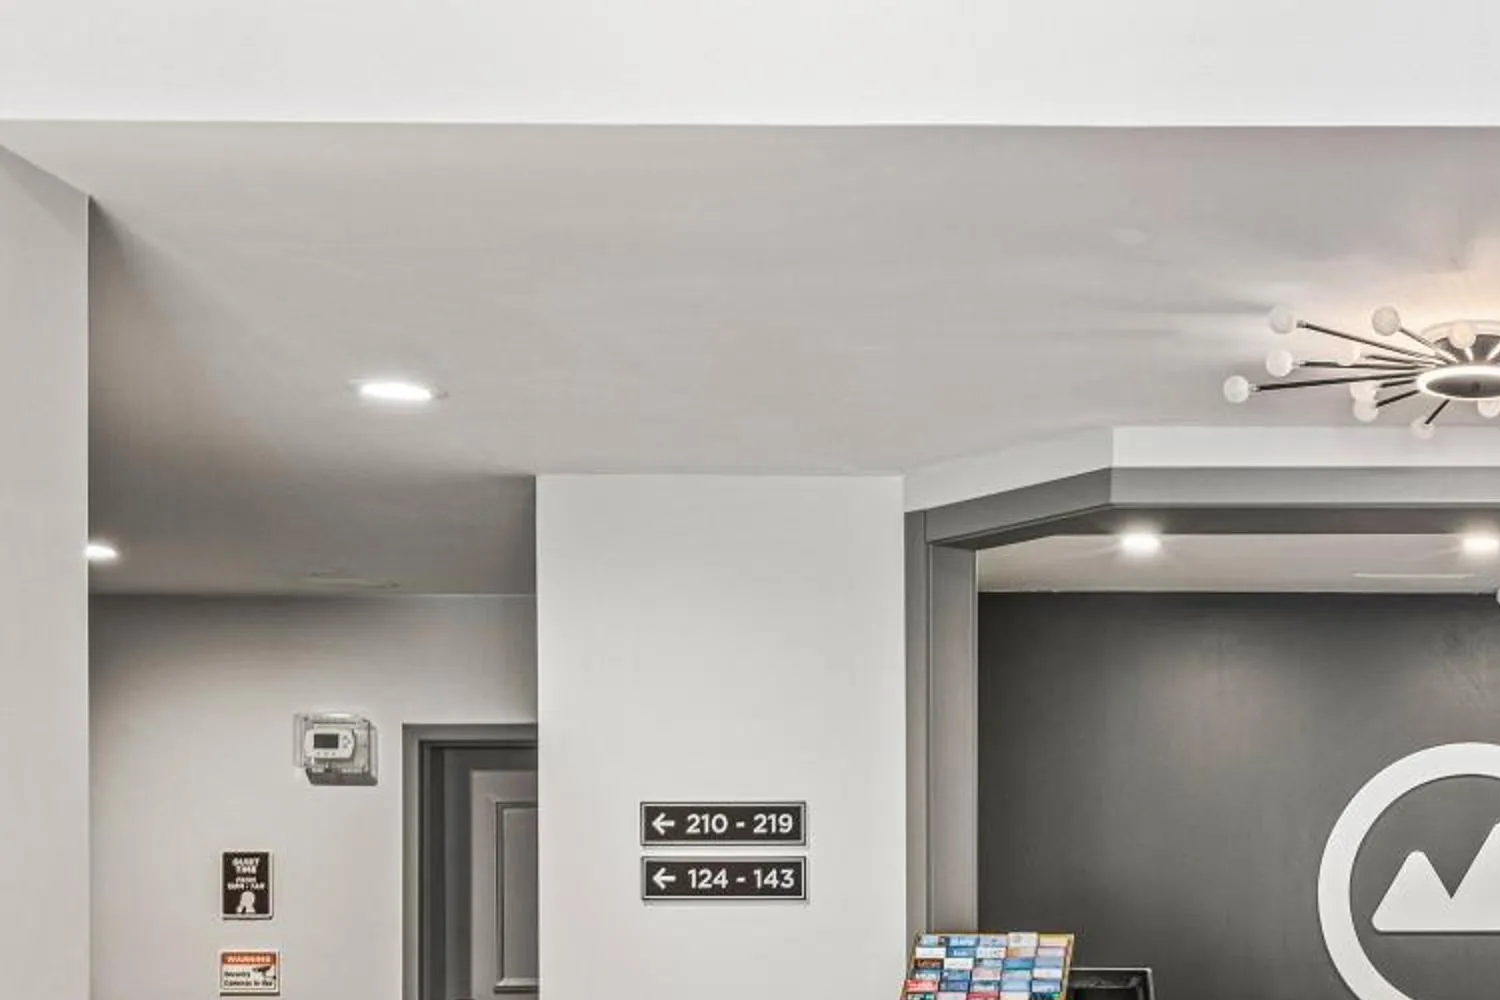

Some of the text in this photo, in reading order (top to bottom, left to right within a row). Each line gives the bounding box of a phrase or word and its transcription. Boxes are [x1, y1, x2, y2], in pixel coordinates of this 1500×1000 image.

[686, 813, 728, 834] 210
[753, 813, 793, 834] 219
[688, 868, 729, 889] 124
[754, 868, 795, 889] 143
